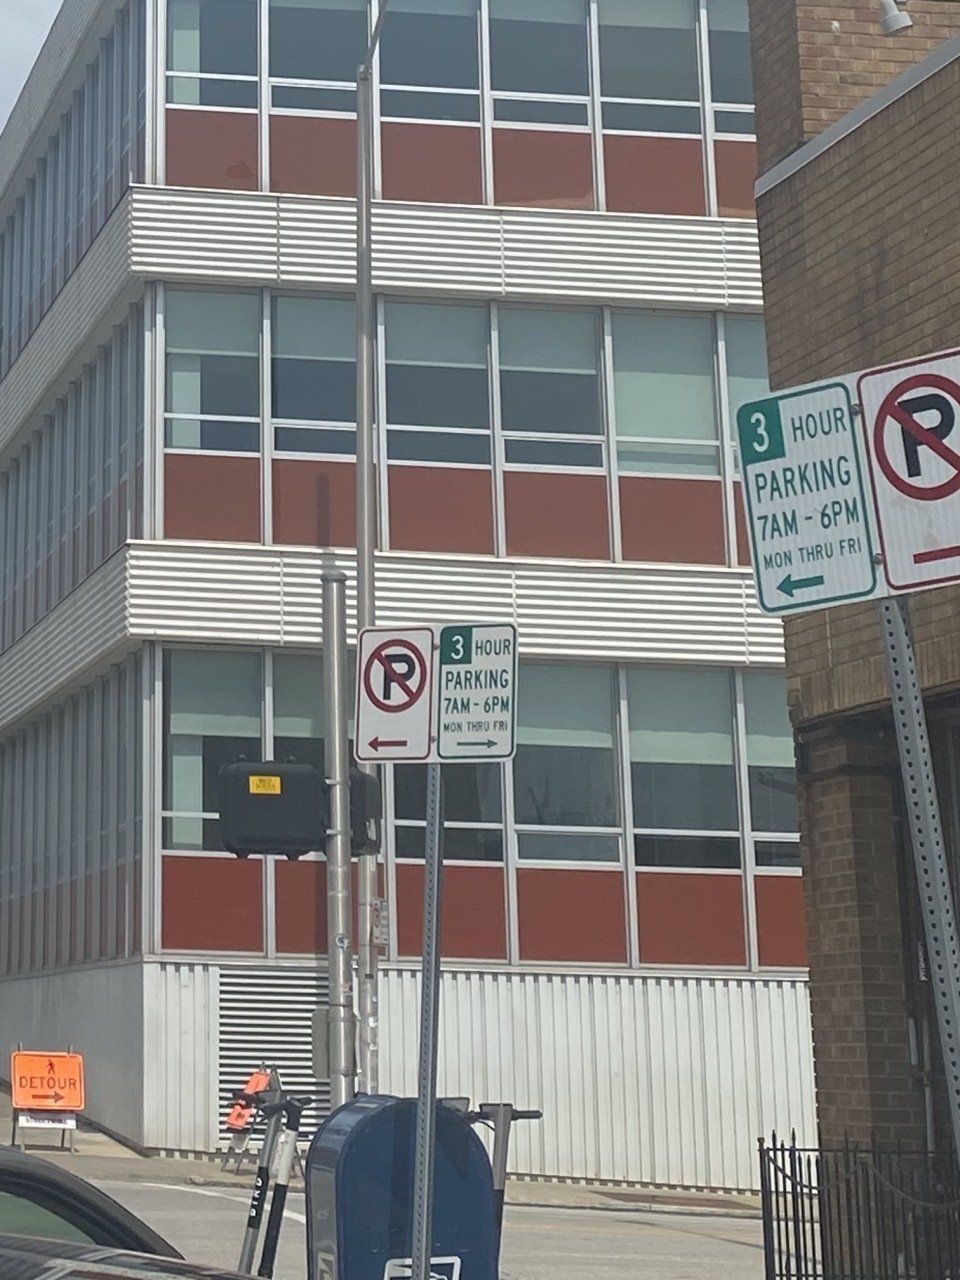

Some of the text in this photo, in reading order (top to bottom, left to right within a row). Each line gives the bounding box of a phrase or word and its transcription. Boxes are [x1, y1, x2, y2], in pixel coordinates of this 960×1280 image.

[750, 407, 847, 453] 3 HOUR
[754, 456, 851, 504] PARKING
[757, 509, 799, 541] 7AM
[820, 497, 860, 530] 6PM
[763, 537, 862, 571] MON THRU FRI
[451, 635, 511, 660] 3 HOUR
[445, 669, 509, 690] PARKING
[444, 698, 470, 714] 7AM
[484, 696, 509, 713] 6PM
[444, 721, 508, 733] MON THRU FRI
[19, 1076, 77, 1090] DETOUR
[249, 1177, 262, 1217] BIRD
